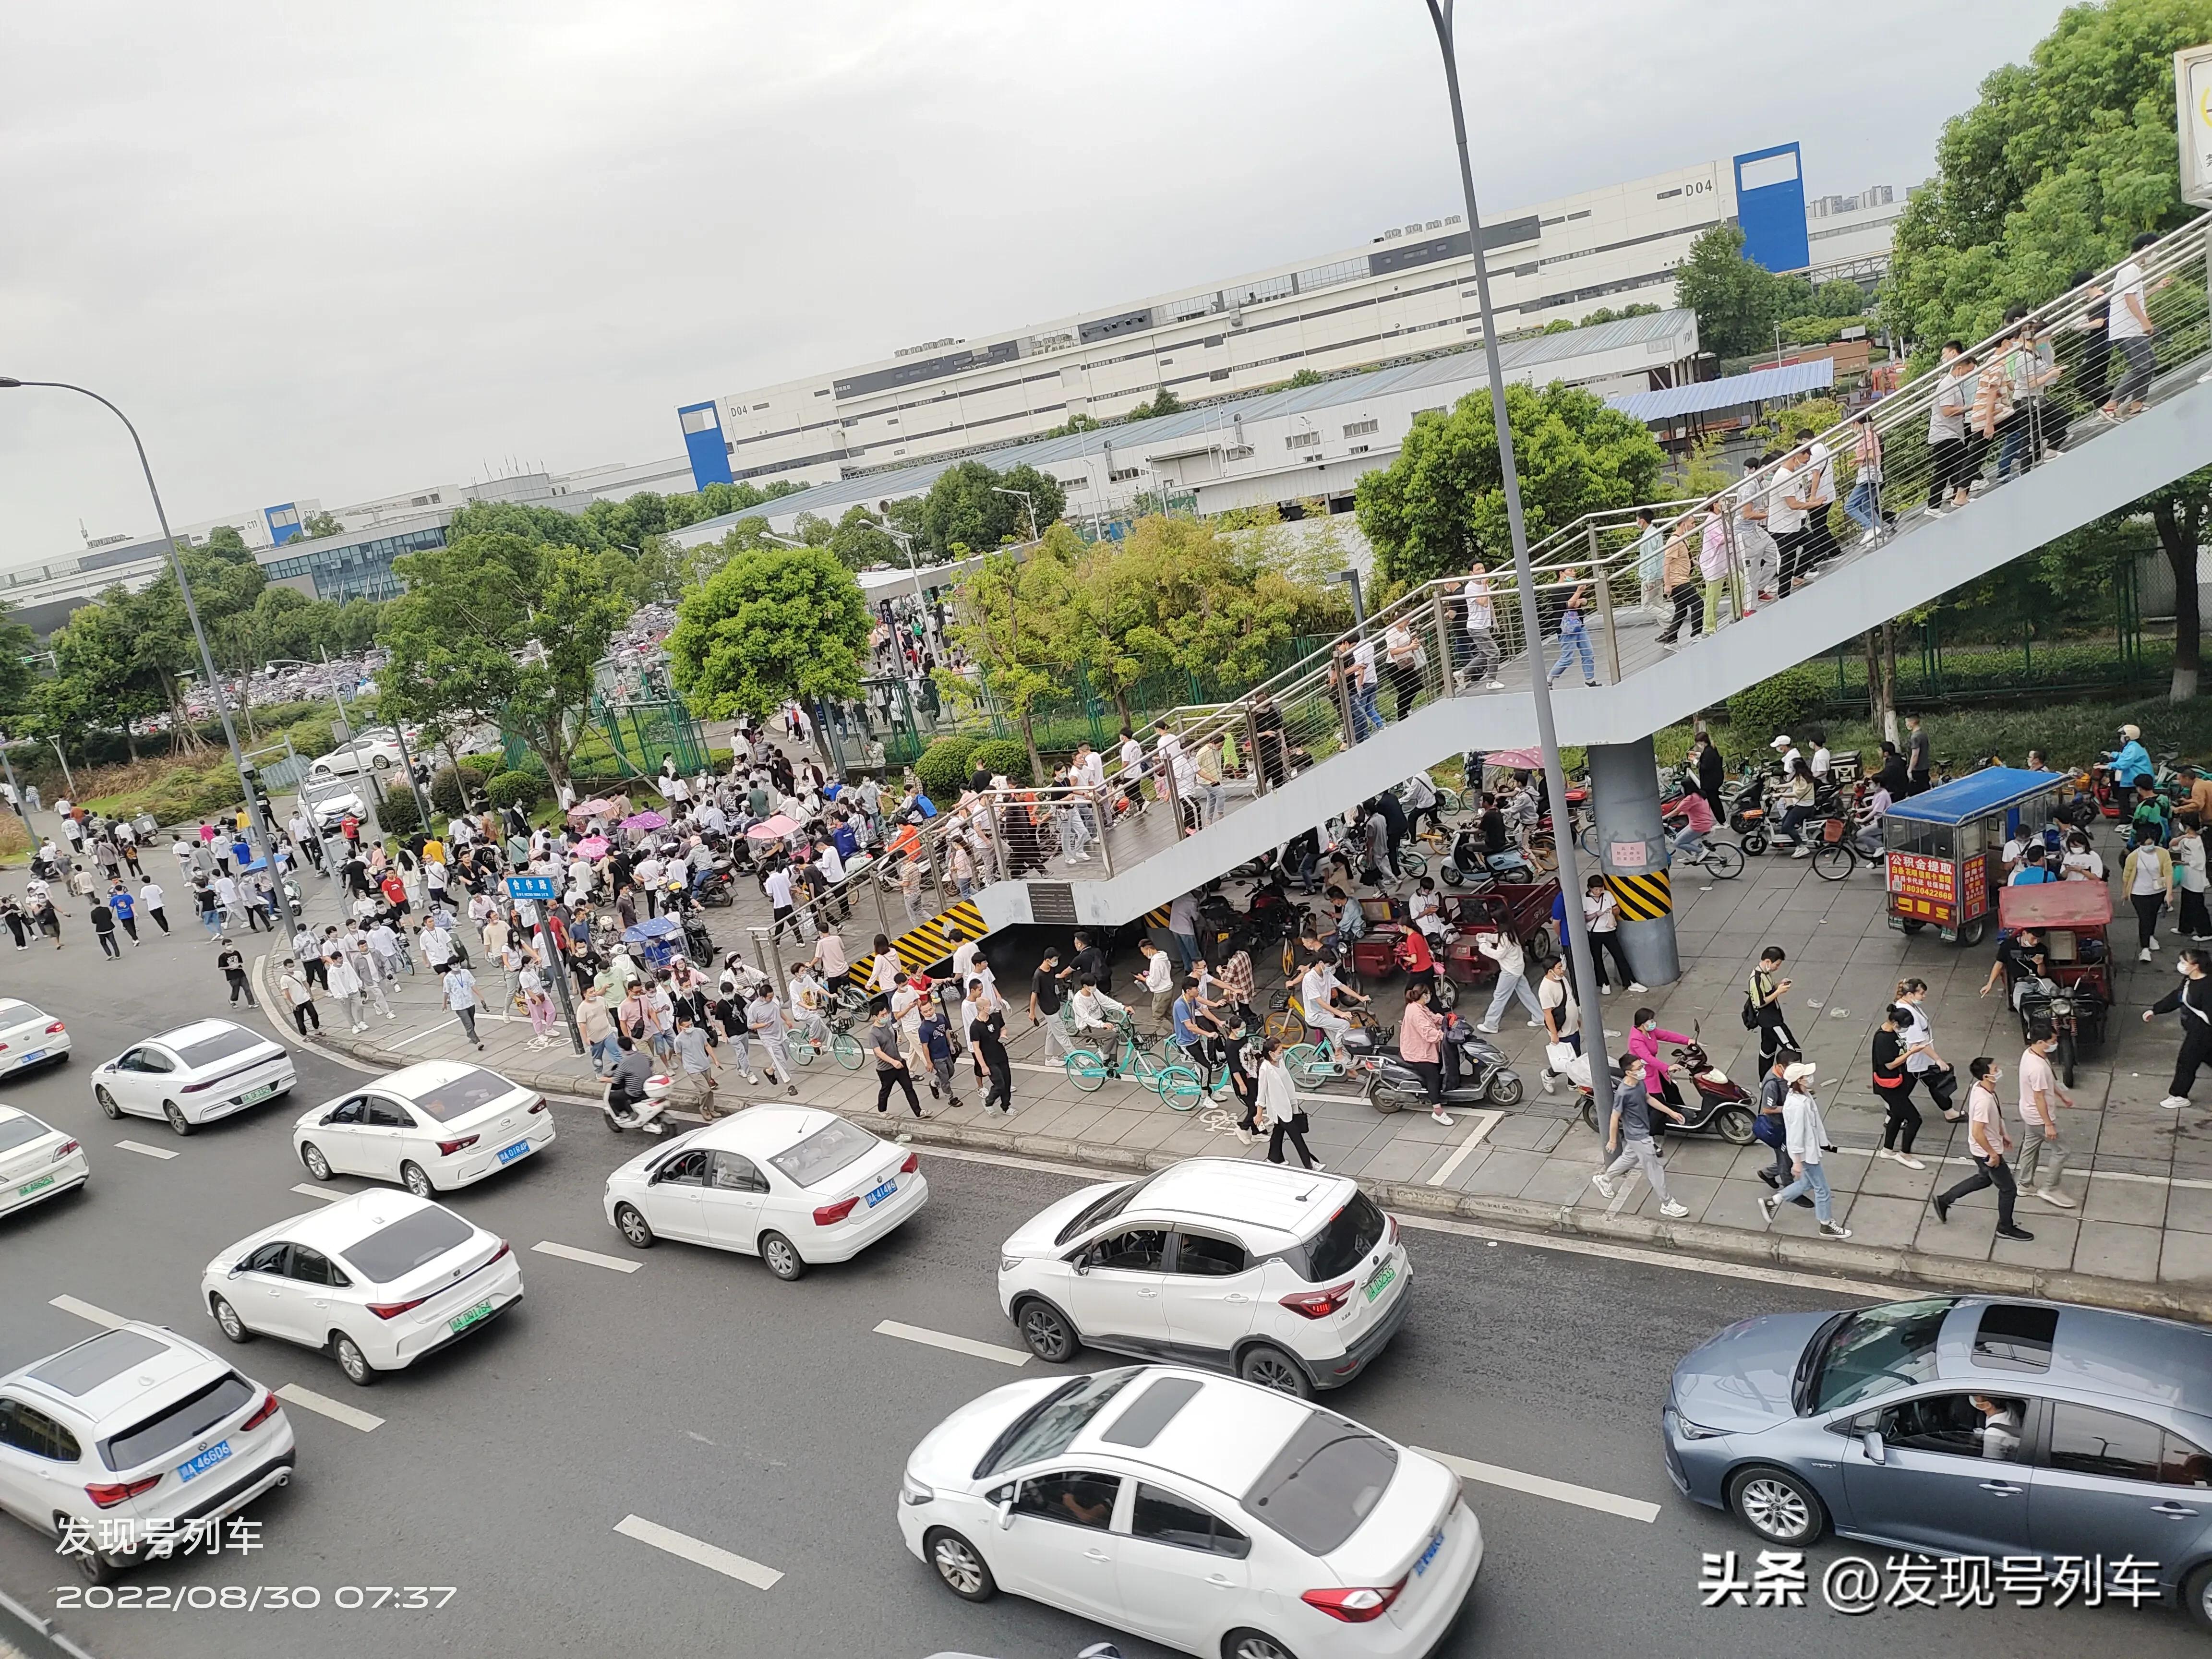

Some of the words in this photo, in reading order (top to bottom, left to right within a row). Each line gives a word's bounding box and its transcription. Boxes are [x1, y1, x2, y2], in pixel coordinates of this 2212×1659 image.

[1685, 179, 1713, 196] D04
[730, 405, 748, 417] D04
[247, 520, 258, 529] C11
[1890, 854, 1952, 875] 公积金提取
[512, 879, 547, 890] 合作路
